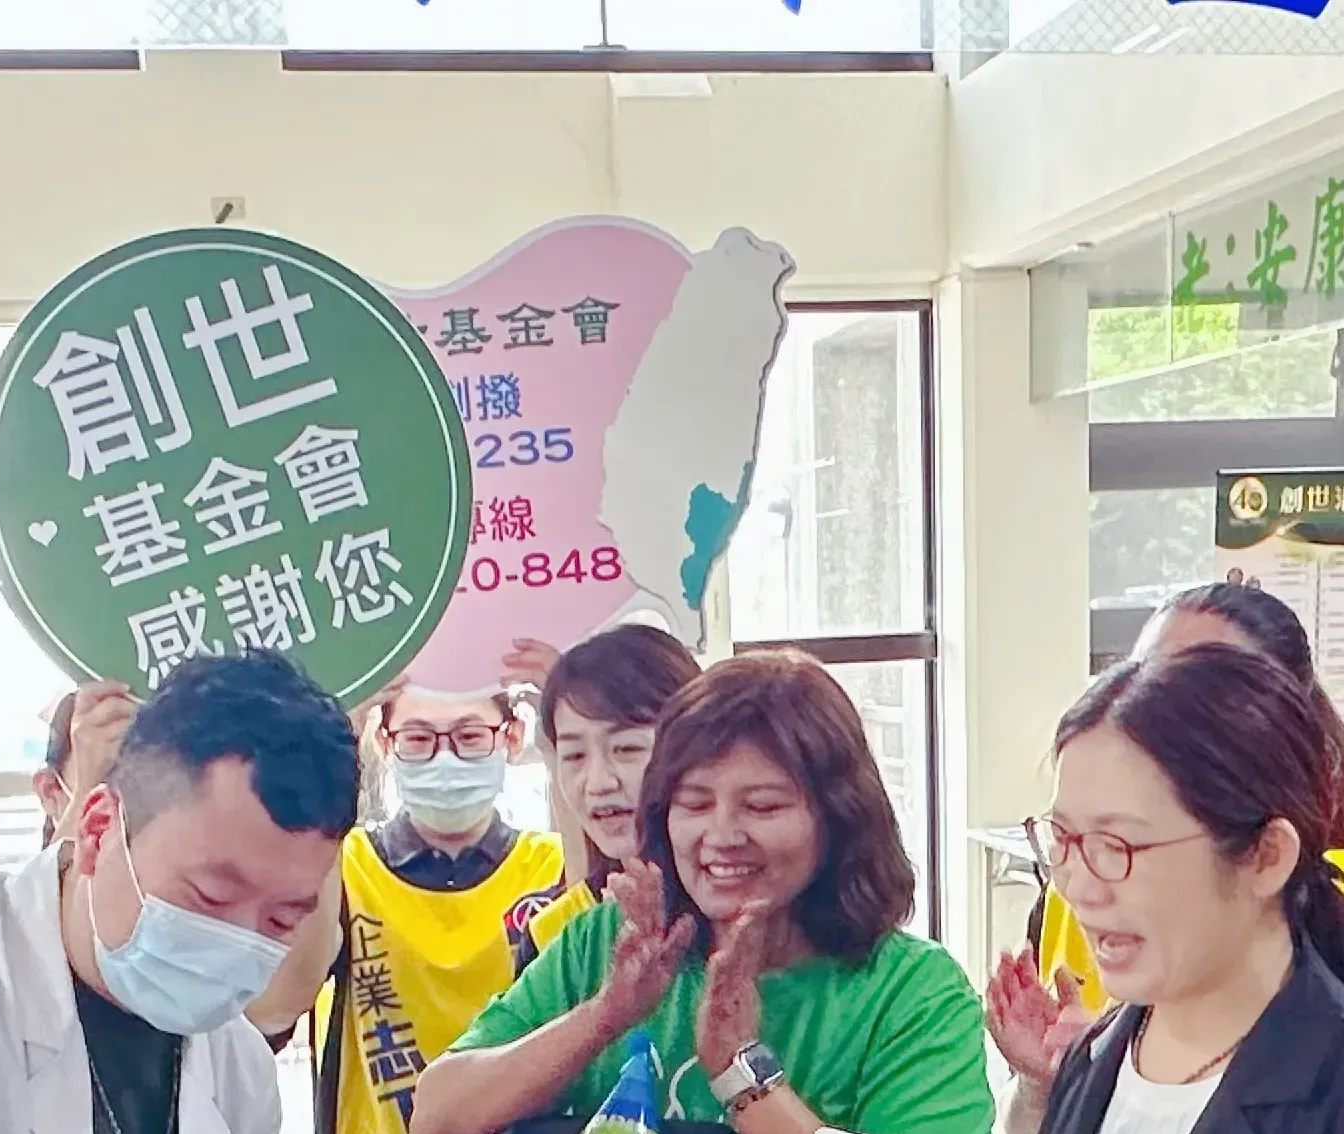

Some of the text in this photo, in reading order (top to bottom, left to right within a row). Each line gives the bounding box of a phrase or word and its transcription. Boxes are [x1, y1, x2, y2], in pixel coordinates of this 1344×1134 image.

[32, 263, 338, 482] 創世
[408, 295, 621, 357] 基金會
[473, 426, 575, 469] 235
[83, 423, 370, 587] 基金會
[126, 527, 414, 690] 感謝您
[456, 546, 623, 593] 0-848
